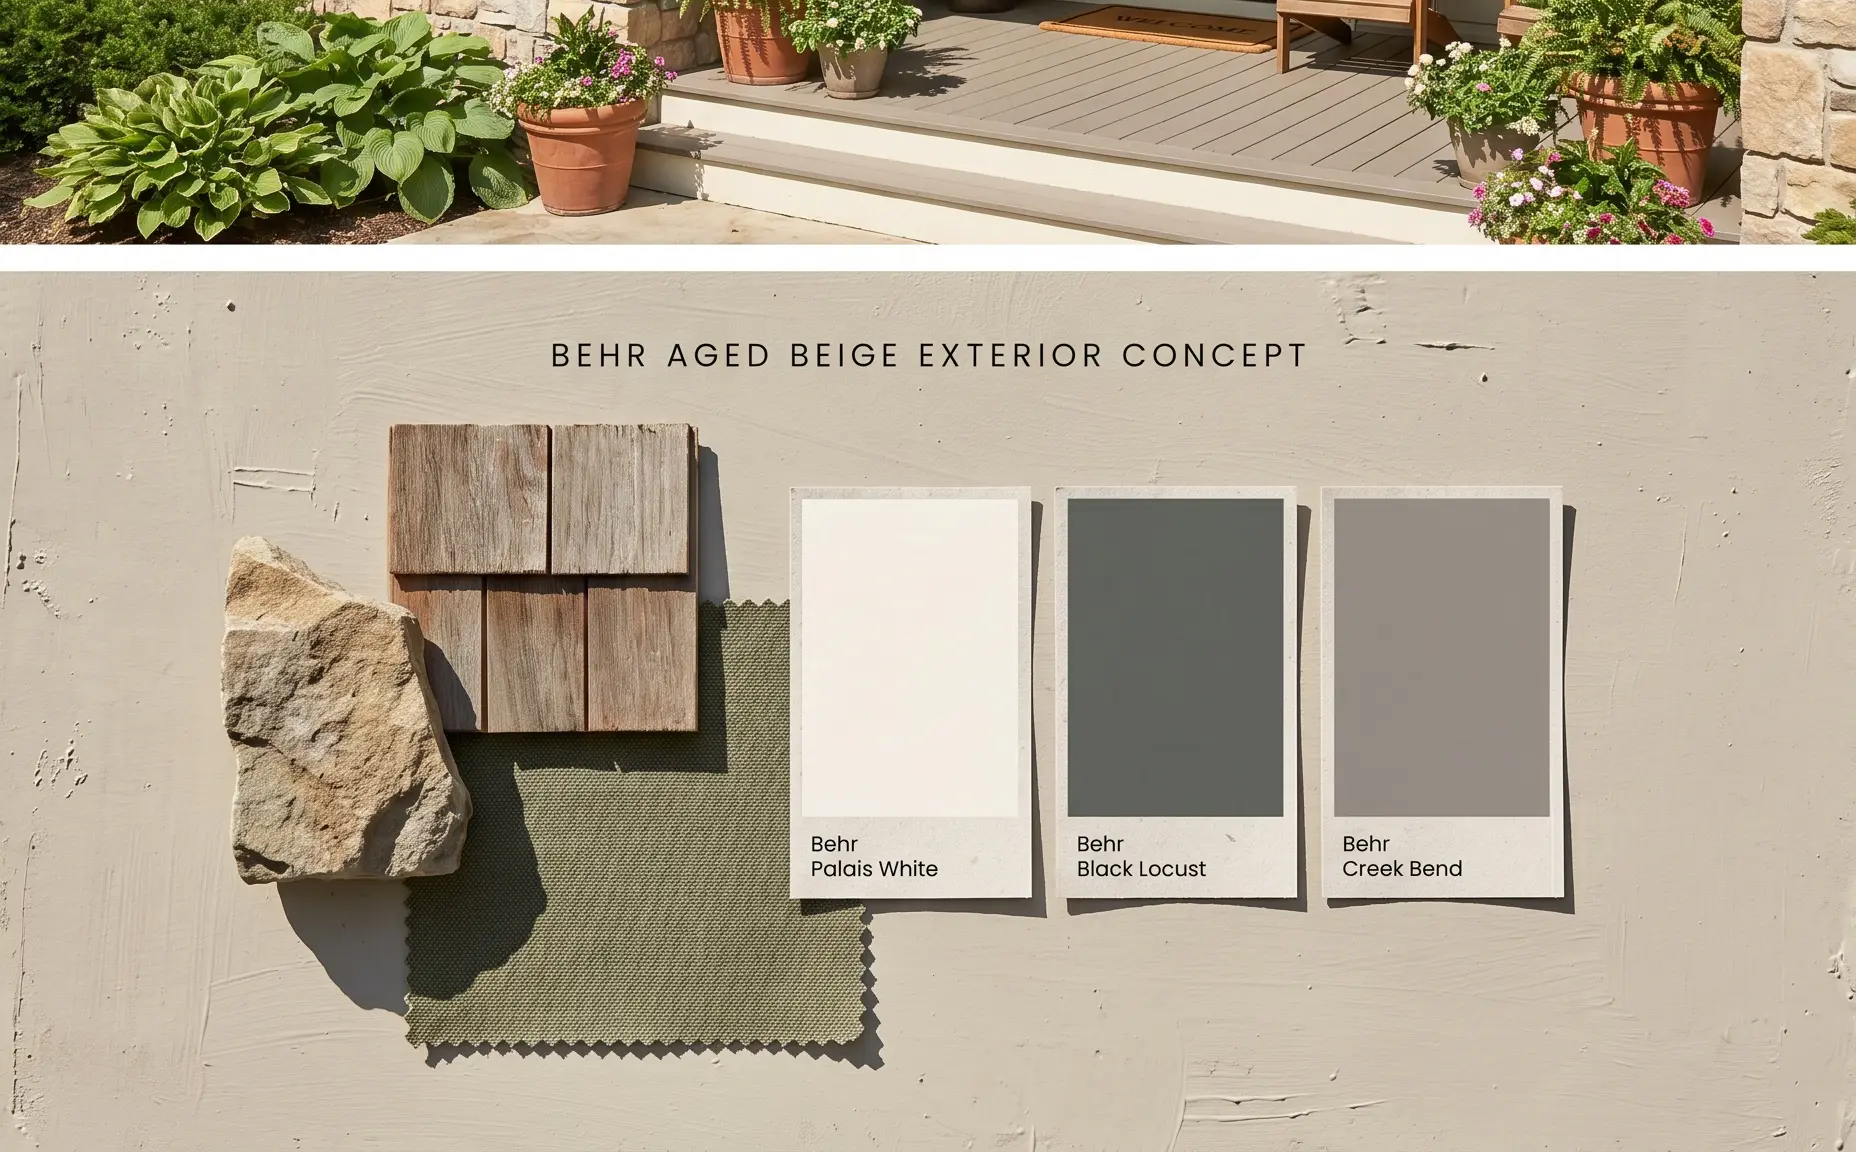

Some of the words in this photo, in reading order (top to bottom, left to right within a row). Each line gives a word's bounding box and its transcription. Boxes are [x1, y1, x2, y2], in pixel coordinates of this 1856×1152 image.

[1117, 15, 1256, 35] WELCOME
[811, 835, 859, 853] Behr
[1077, 835, 1125, 853] Behr
[1343, 834, 1390, 852] Behr
[811, 859, 873, 877] Palais
[878, 859, 939, 877] White
[1077, 859, 1133, 877] Black
[1139, 859, 1207, 877] Locust
[1342, 859, 1404, 877] Creek
[1410, 859, 1462, 877] Bend
